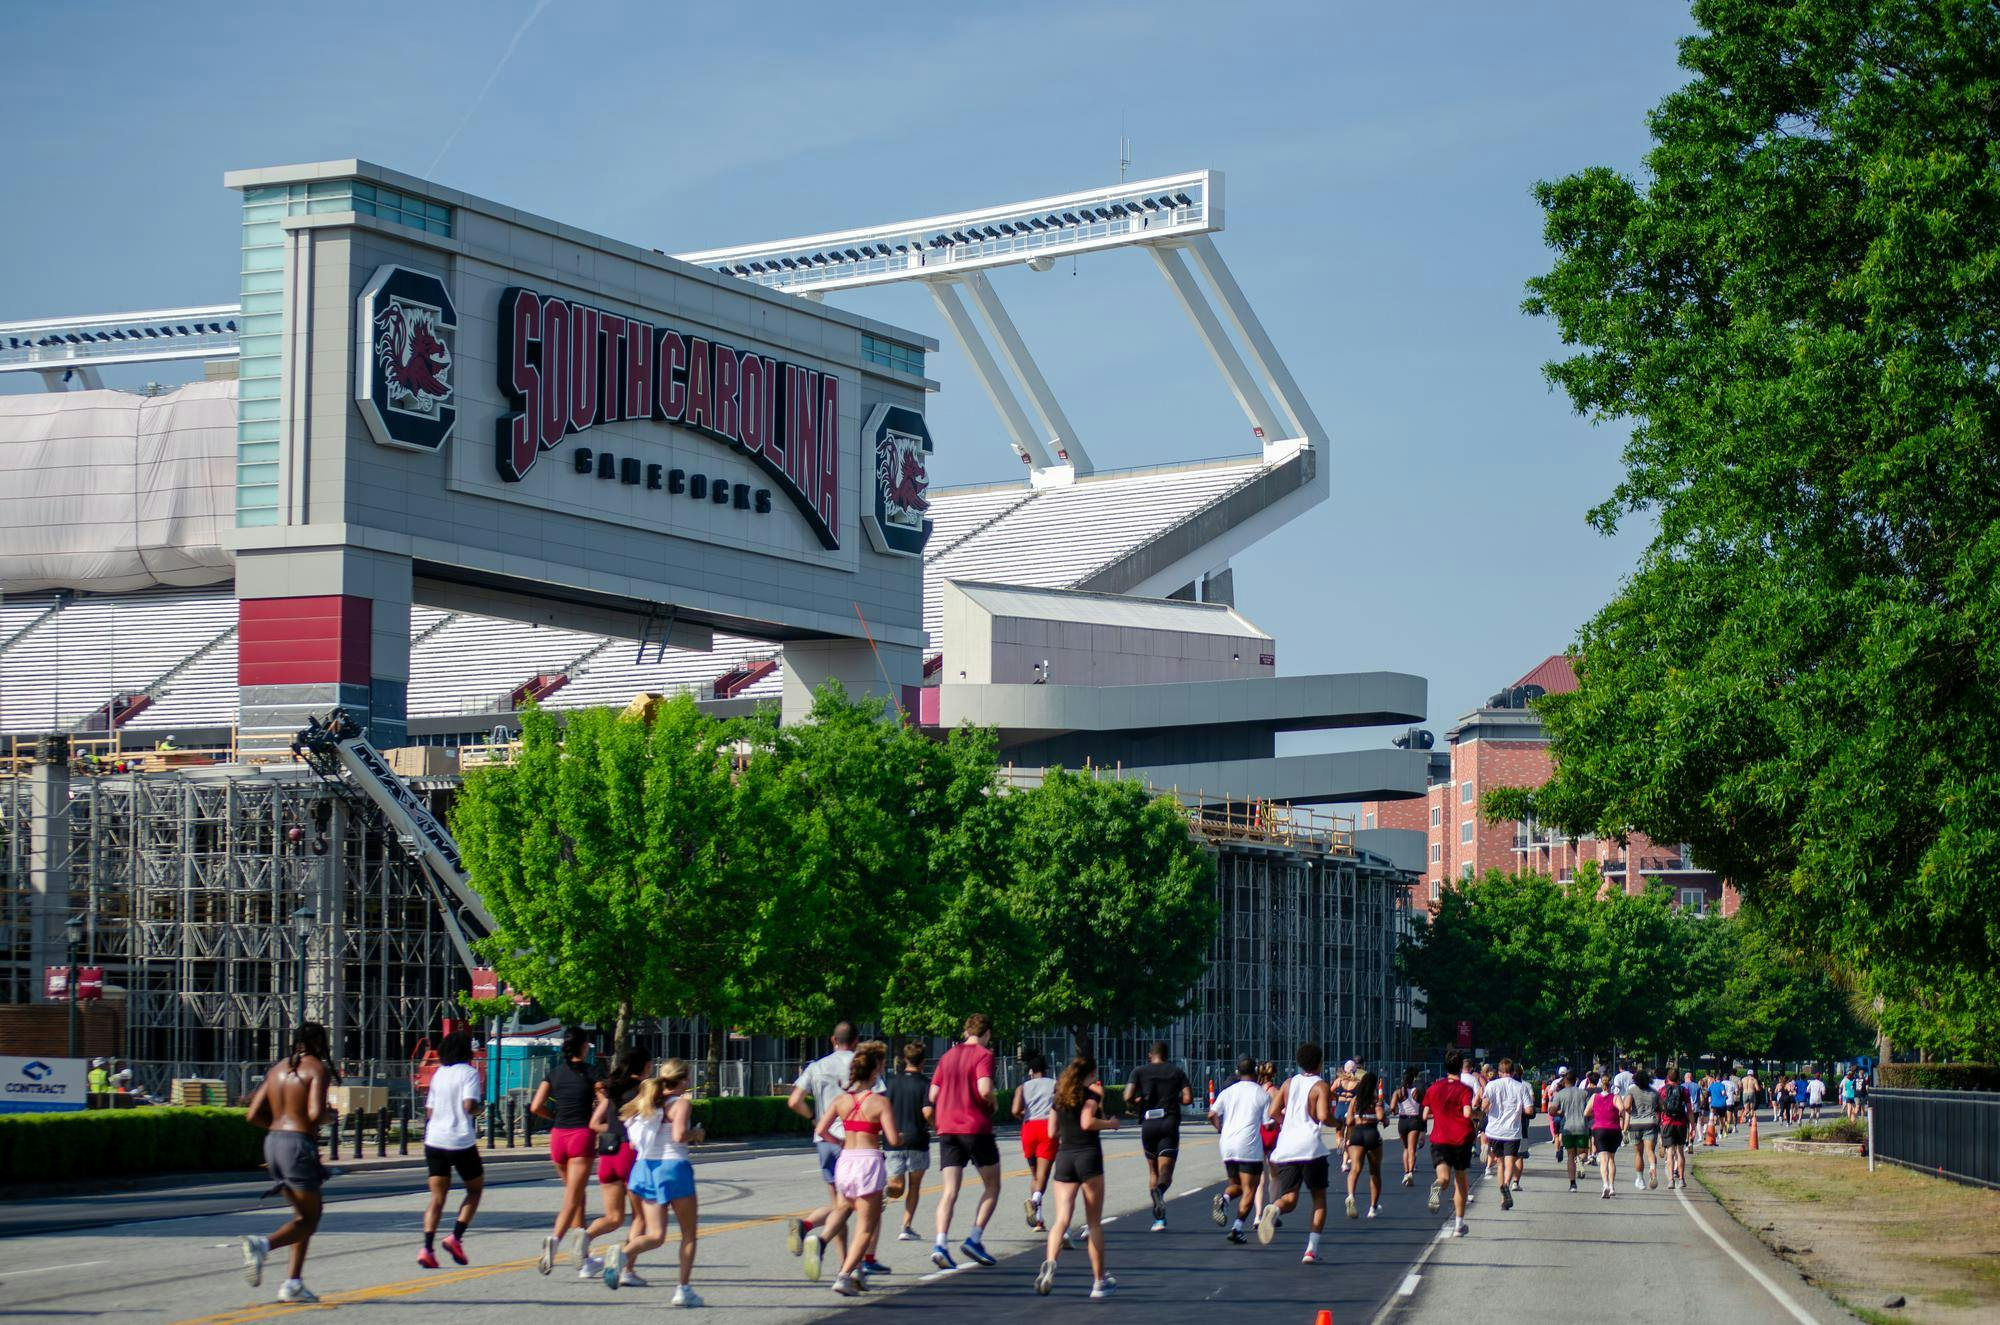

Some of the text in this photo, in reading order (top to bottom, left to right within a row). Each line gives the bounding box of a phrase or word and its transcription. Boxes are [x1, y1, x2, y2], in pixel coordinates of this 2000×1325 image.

[498, 287, 840, 551] SOUTH CAROLINA
[575, 447, 771, 514] GAMECOCKS
[350, 743, 460, 865] MAXIM
[5, 1082, 67, 1095] CONTRACT
